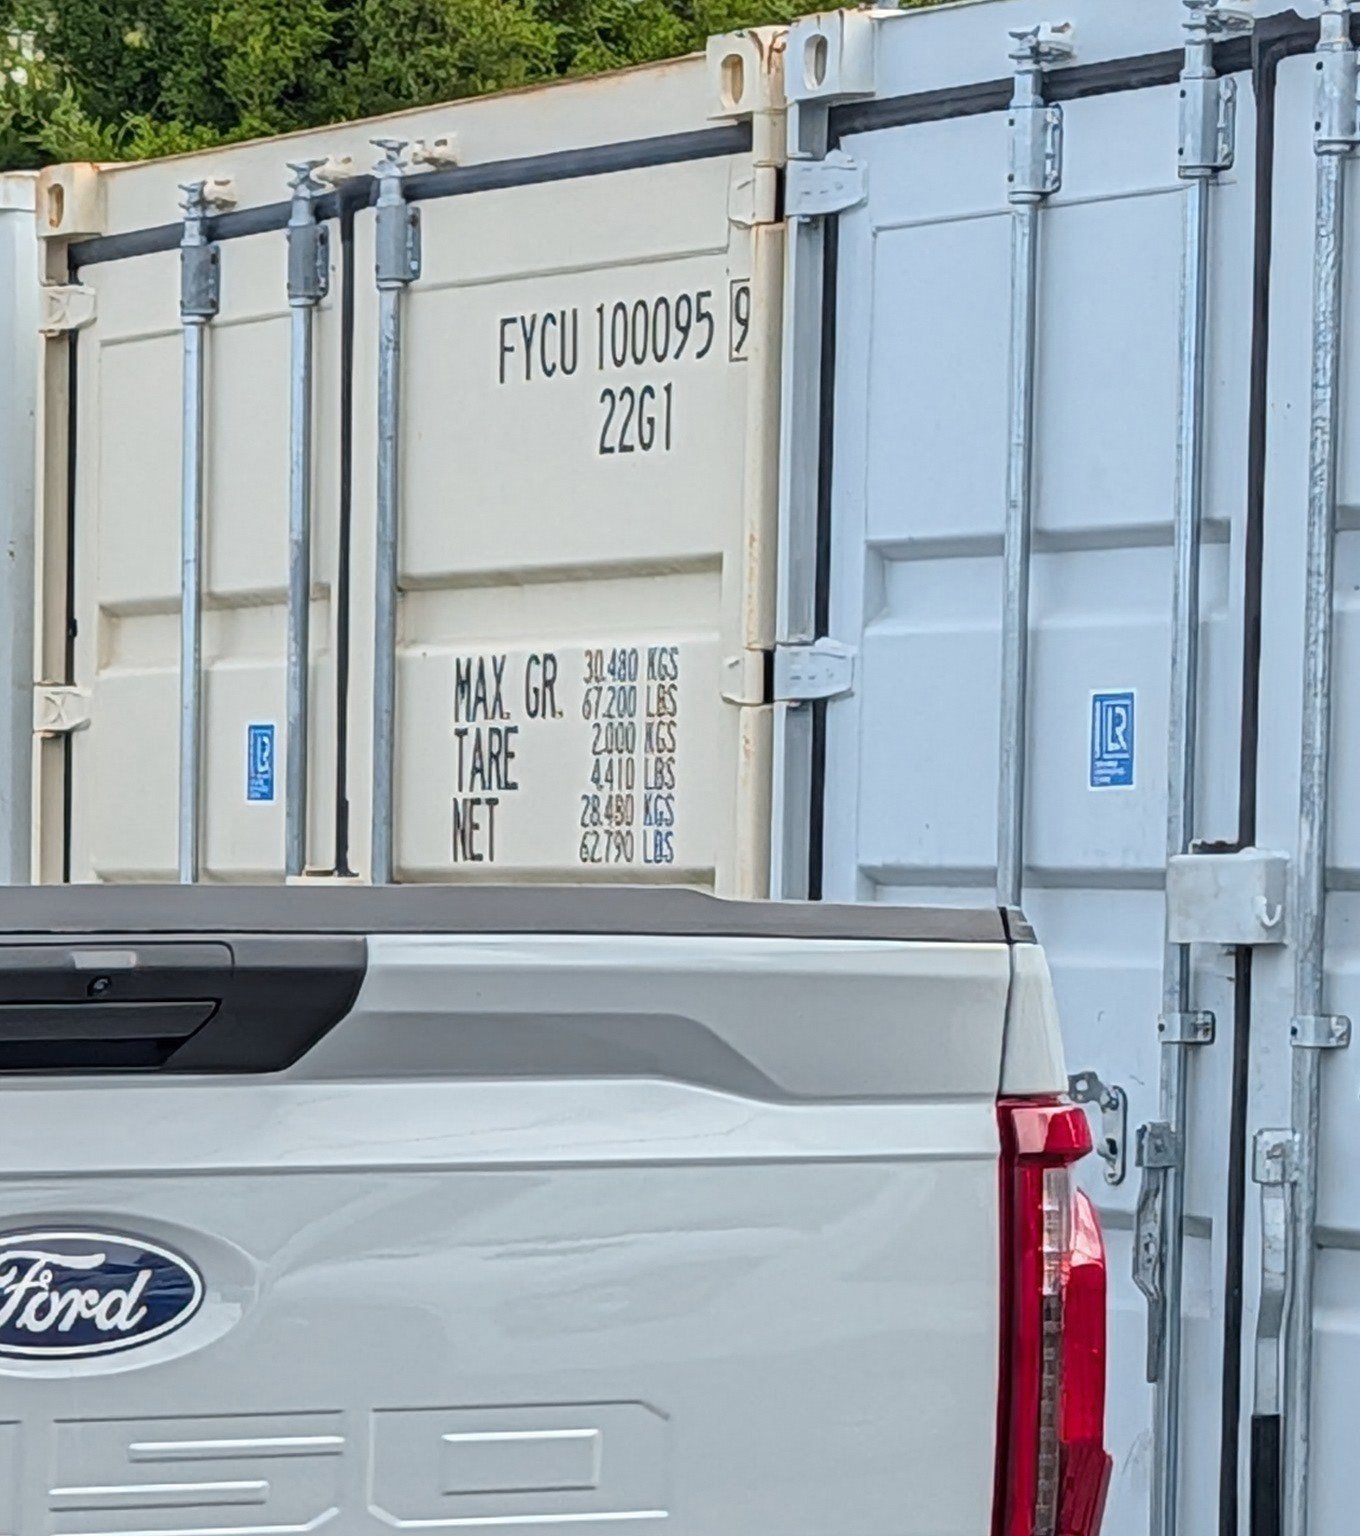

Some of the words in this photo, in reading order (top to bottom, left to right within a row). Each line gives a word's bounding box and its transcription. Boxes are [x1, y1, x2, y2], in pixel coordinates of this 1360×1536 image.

[499, 306, 578, 384] FYCU
[596, 290, 714, 371] 100095
[735, 286, 750, 353] 9
[599, 382, 672, 455] 22G1
[454, 654, 511, 723] MAX.
[524, 653, 564, 719] GR.
[647, 646, 679, 682] KGS
[645, 683, 678, 718] LBS
[454, 725, 519, 792] TARE
[644, 720, 677, 755] KGS
[643, 756, 676, 791] LBS
[452, 797, 500, 863] NET
[643, 793, 675, 827] KGS
[642, 829, 674, 864] LBS
